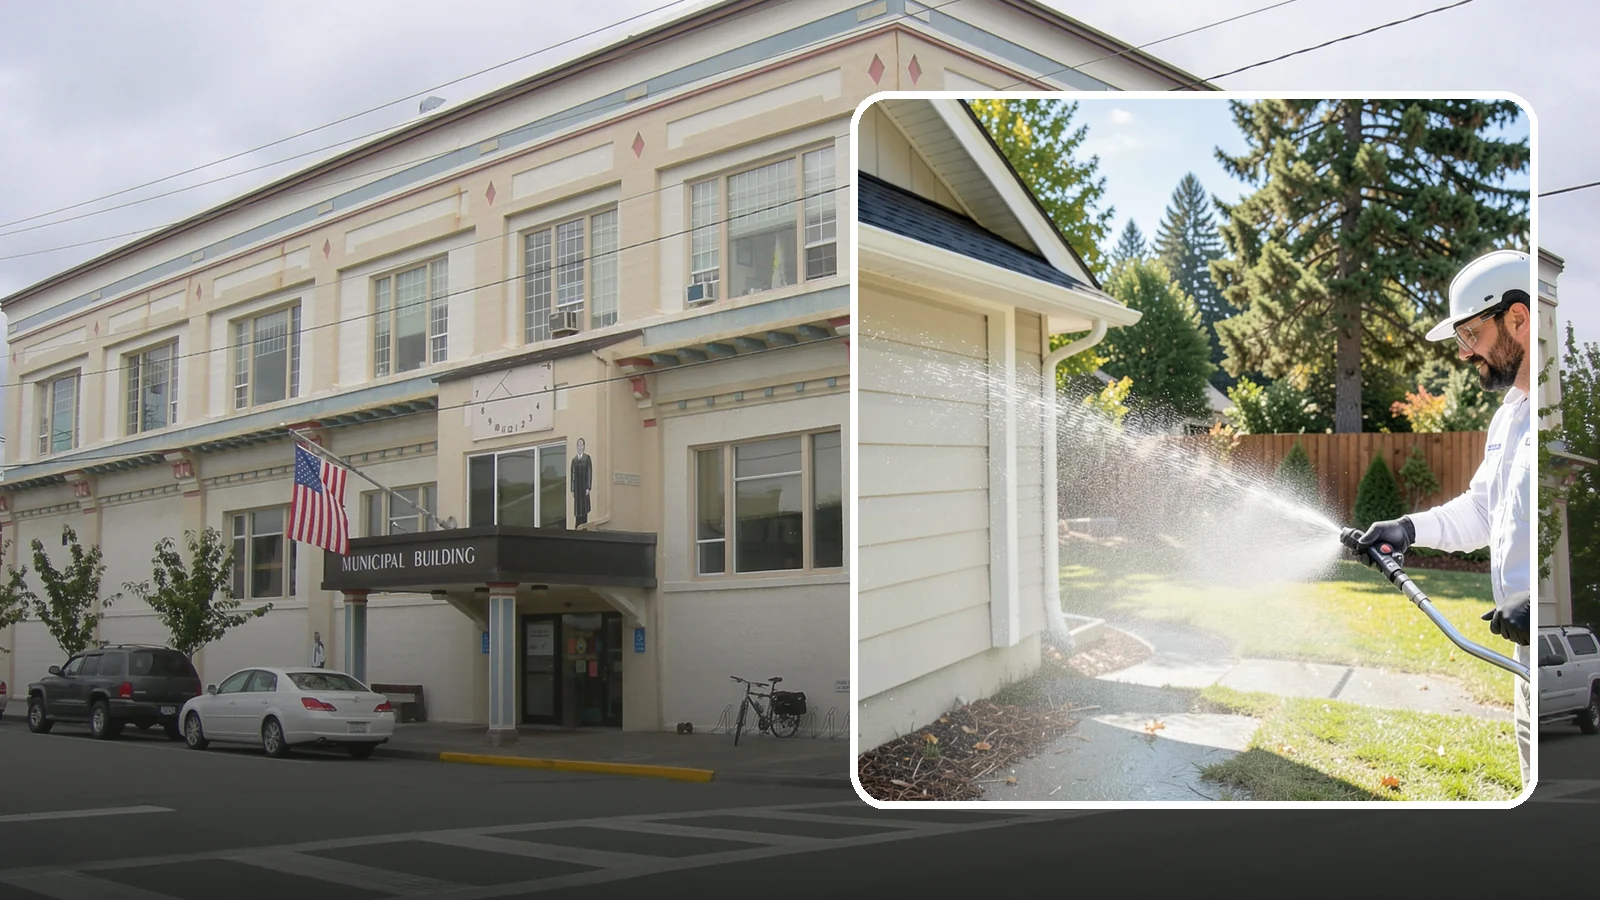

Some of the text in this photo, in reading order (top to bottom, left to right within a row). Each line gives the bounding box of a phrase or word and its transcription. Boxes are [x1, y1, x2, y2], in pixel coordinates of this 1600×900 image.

[480, 406, 485, 415] 8
[536, 402, 540, 410] 4
[487, 417, 493, 426] 9
[528, 414, 533, 422] 3
[494, 423, 500, 432] 10
[507, 425, 513, 433] 12
[521, 420, 526, 428] 2
[342, 546, 475, 572] MUNICIPAL BUILDING
